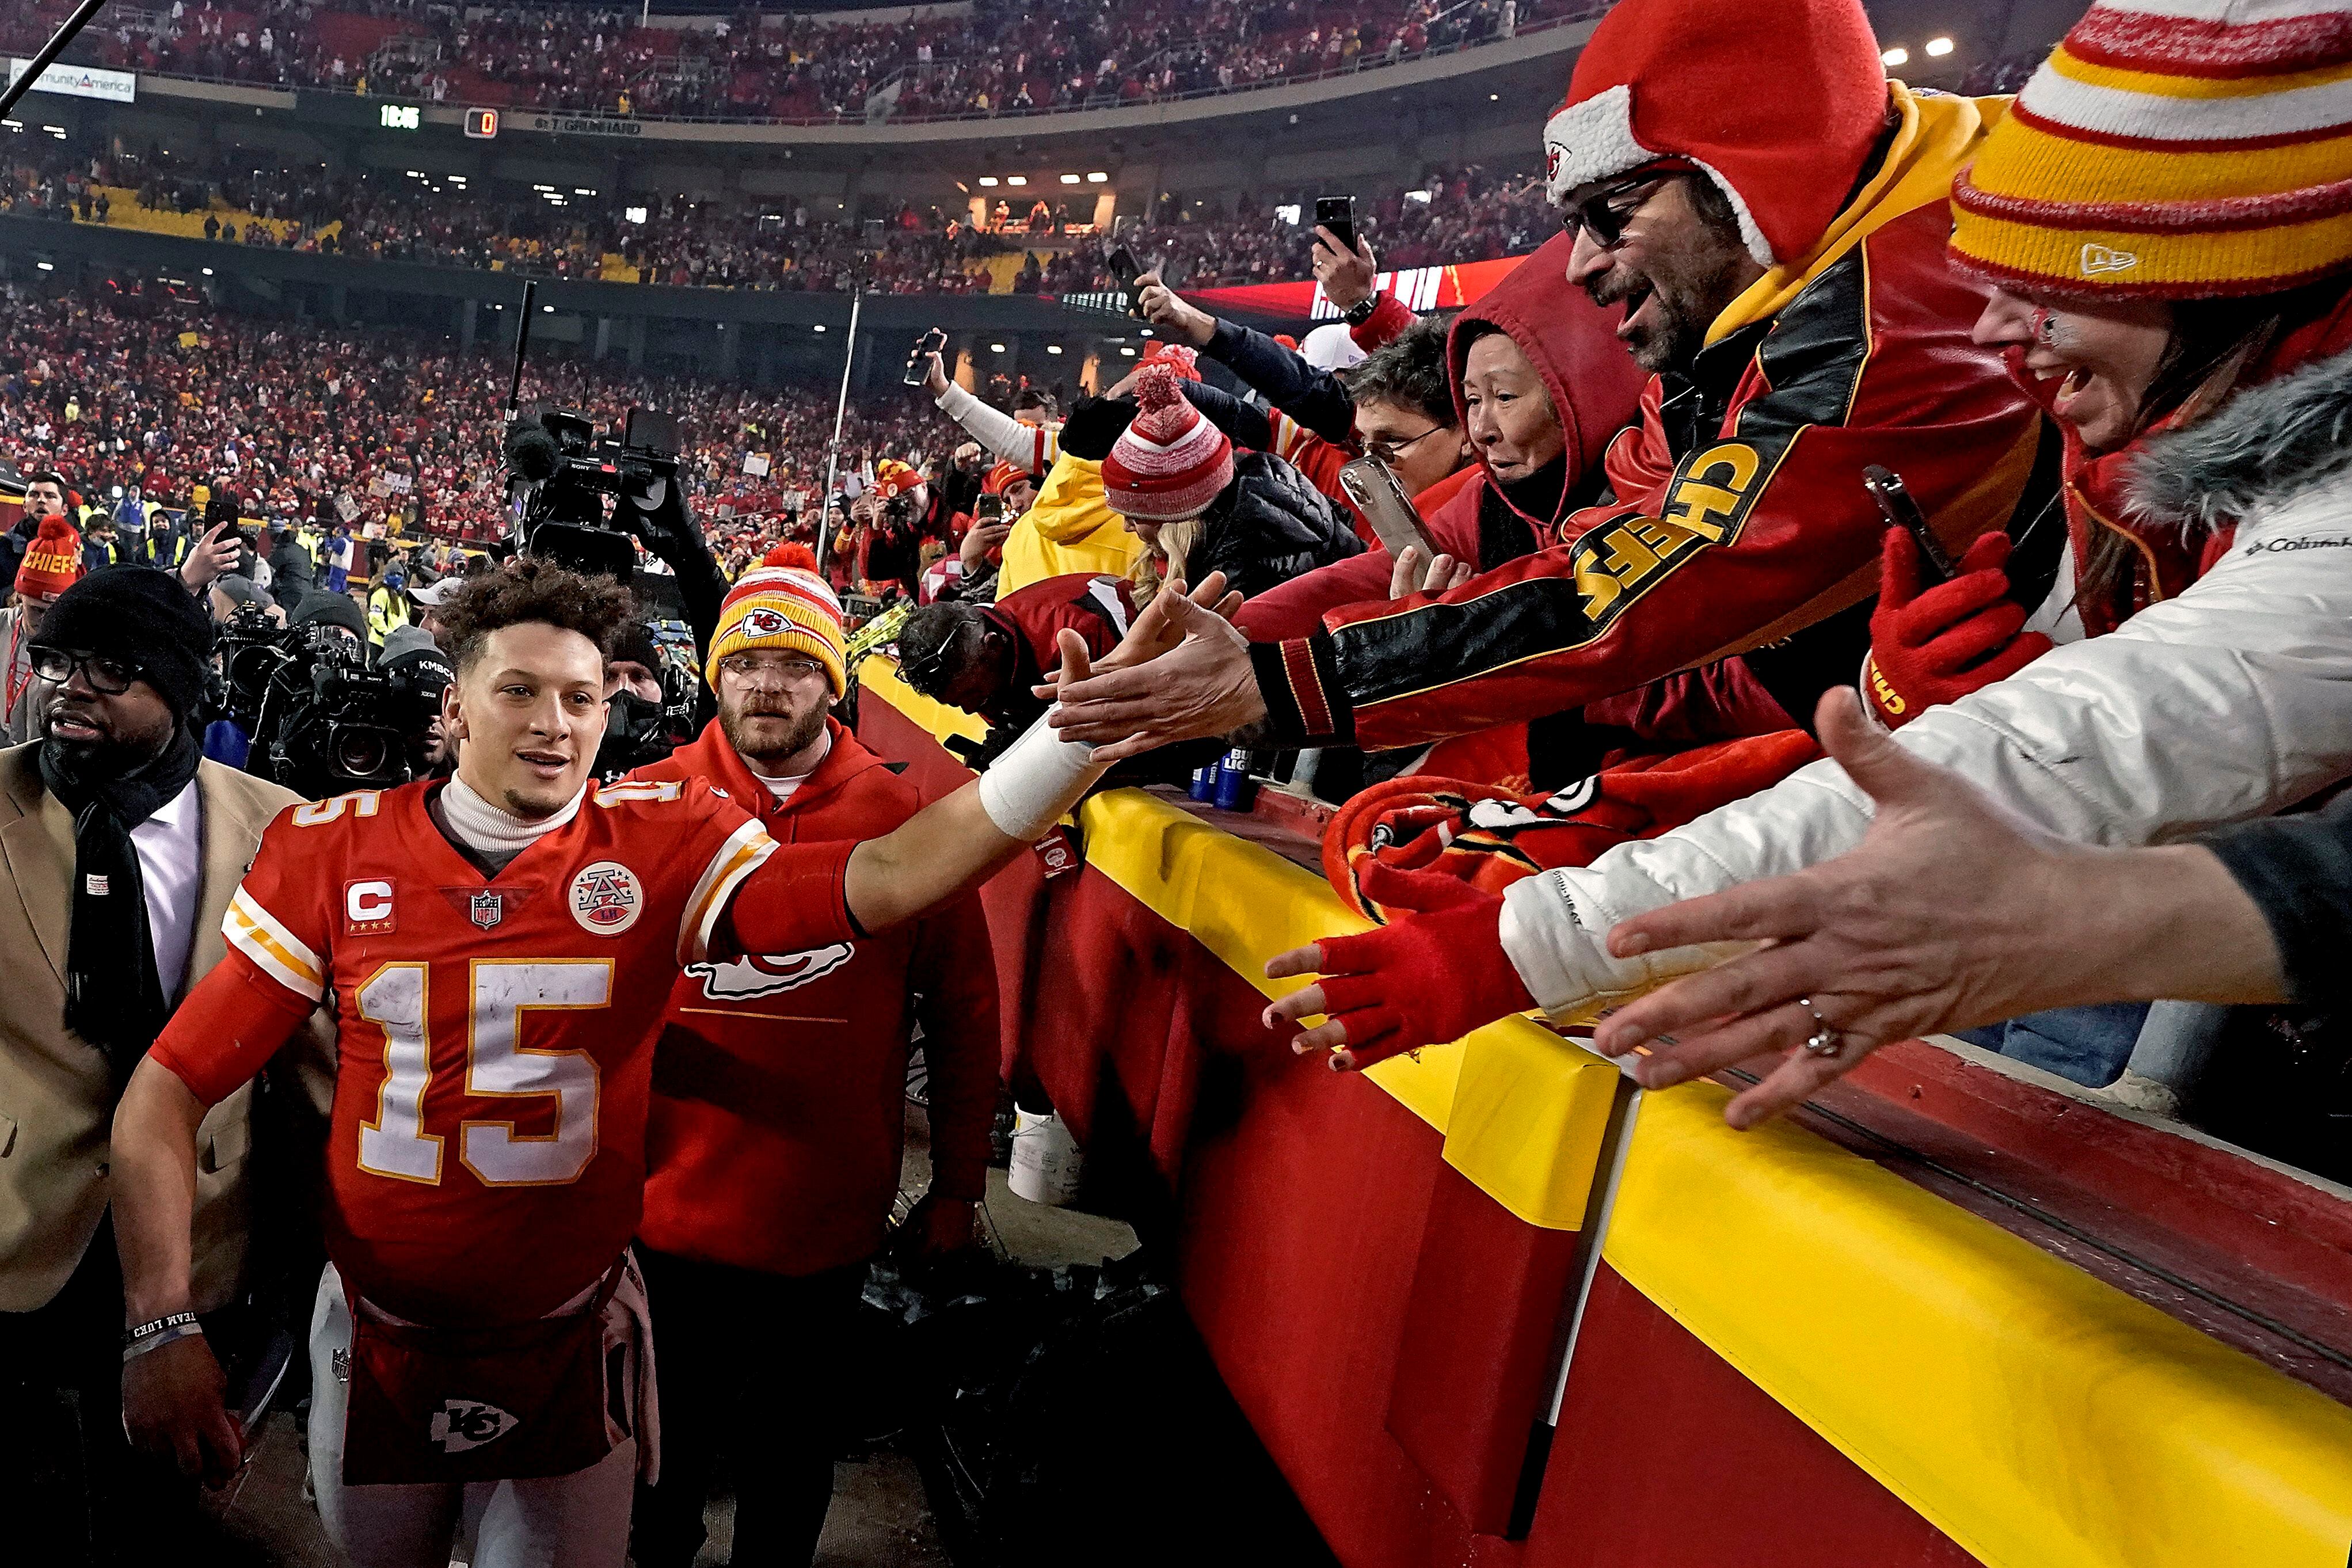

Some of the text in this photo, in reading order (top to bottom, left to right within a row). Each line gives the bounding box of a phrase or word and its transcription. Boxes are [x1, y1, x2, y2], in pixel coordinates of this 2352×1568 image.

[14, 67, 131, 93] CmunityAmerica
[22, 550, 76, 574] CHIEFS
[347, 881, 392, 922] C
[475, 908, 496, 923] NFL
[355, 958, 615, 1187] 15
[166, 1312, 196, 1326] TEAM
